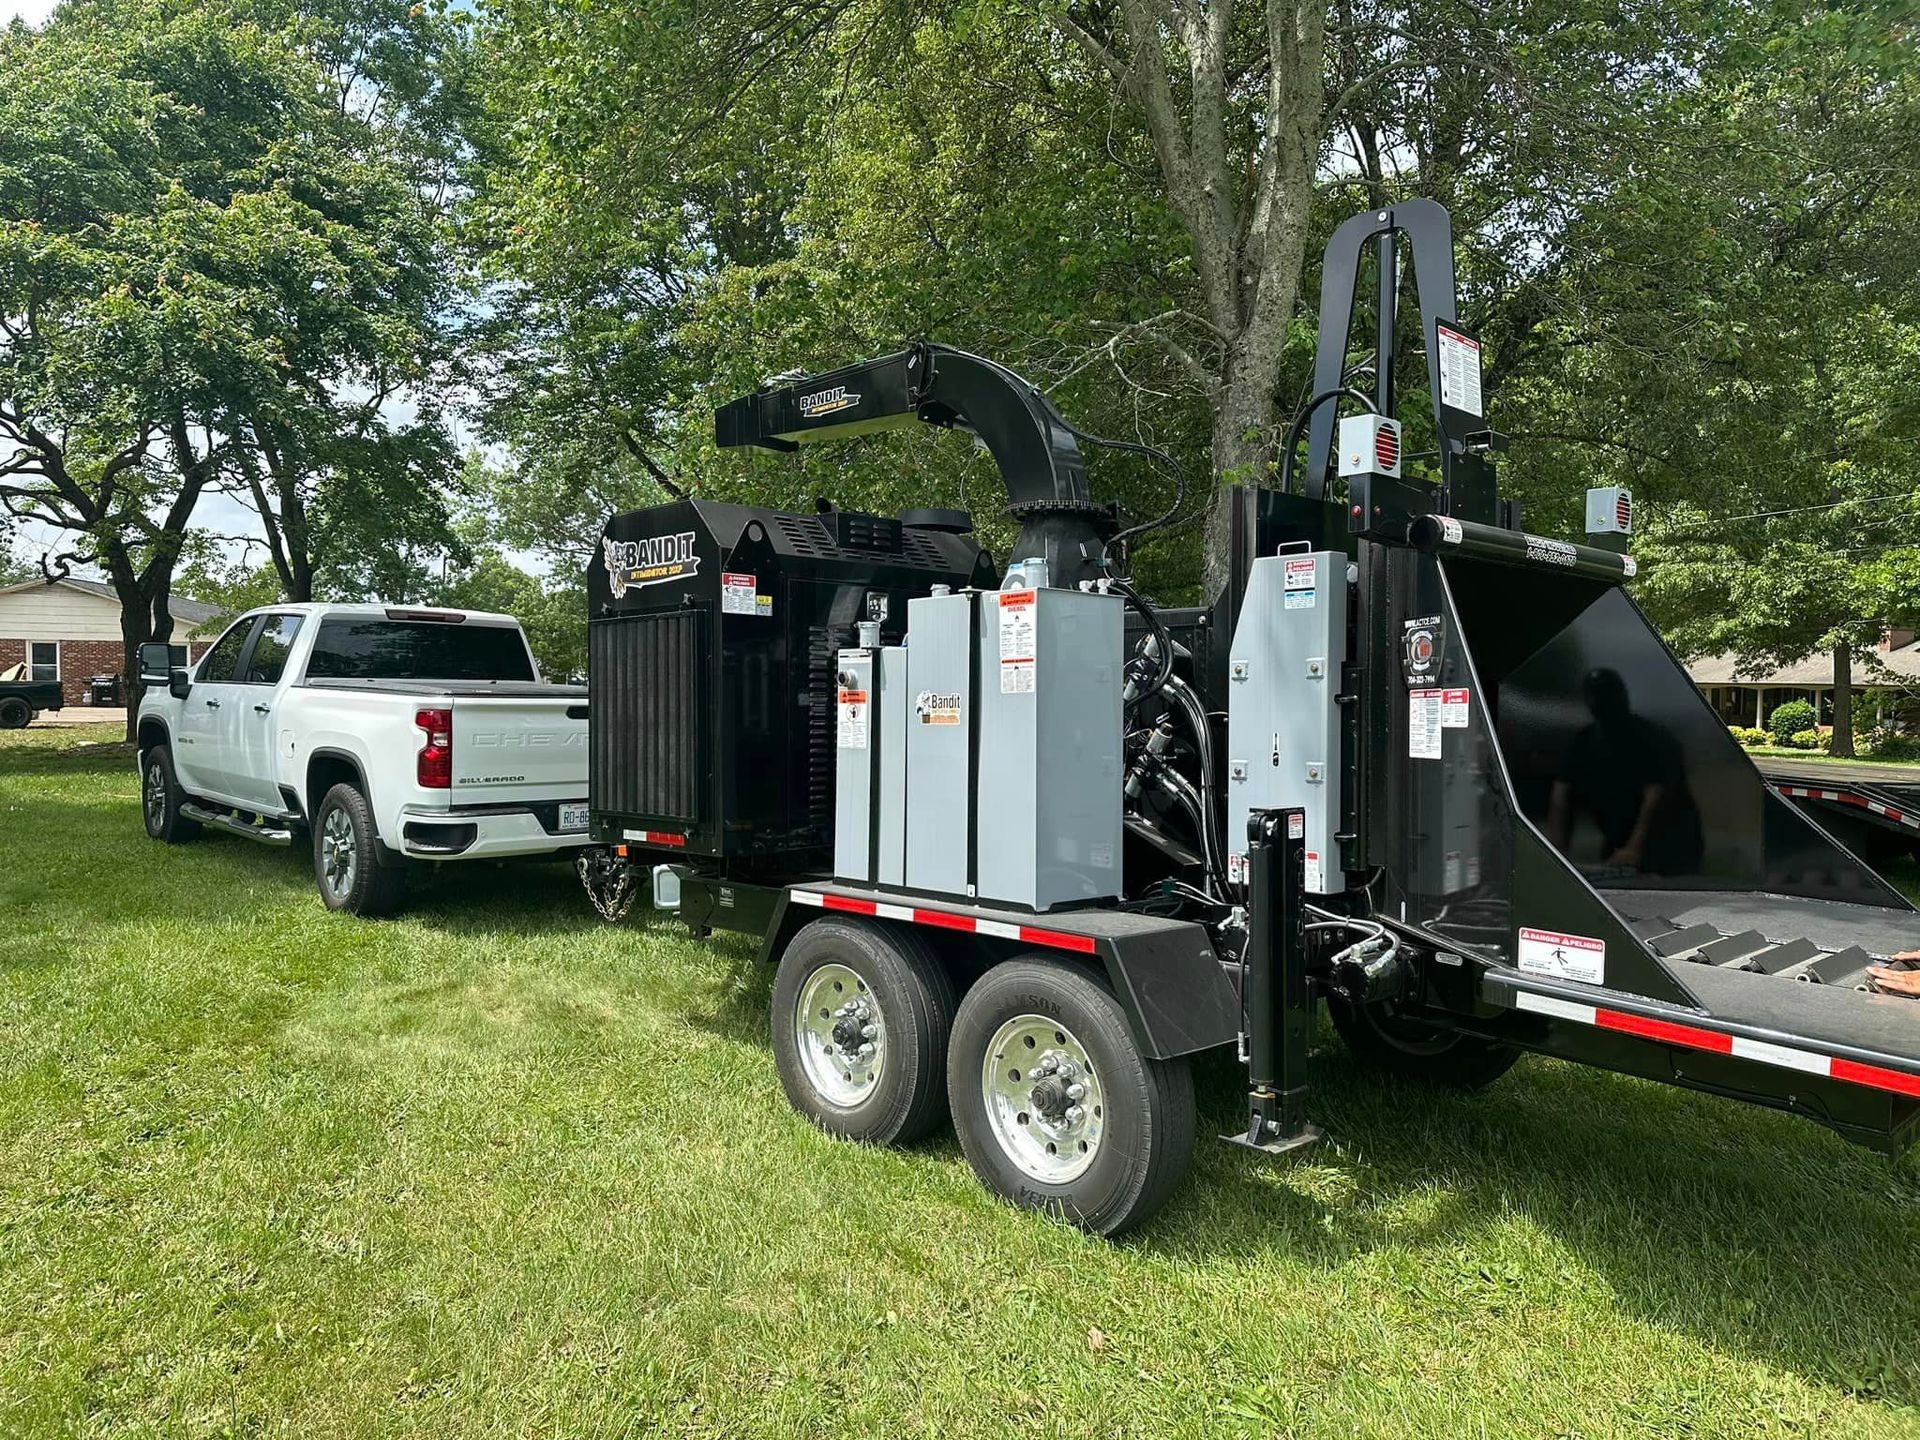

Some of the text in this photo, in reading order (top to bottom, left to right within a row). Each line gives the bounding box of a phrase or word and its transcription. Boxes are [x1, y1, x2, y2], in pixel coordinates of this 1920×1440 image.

[800, 386, 845, 411] BANDIT
[625, 531, 696, 570] BANDIT
[630, 566, 668, 580] INTIMIDATOR
[931, 694, 960, 709] Bandit
[459, 775, 525, 785] SILVERADO
[1530, 932, 1602, 951] DANGER PELIGRO
